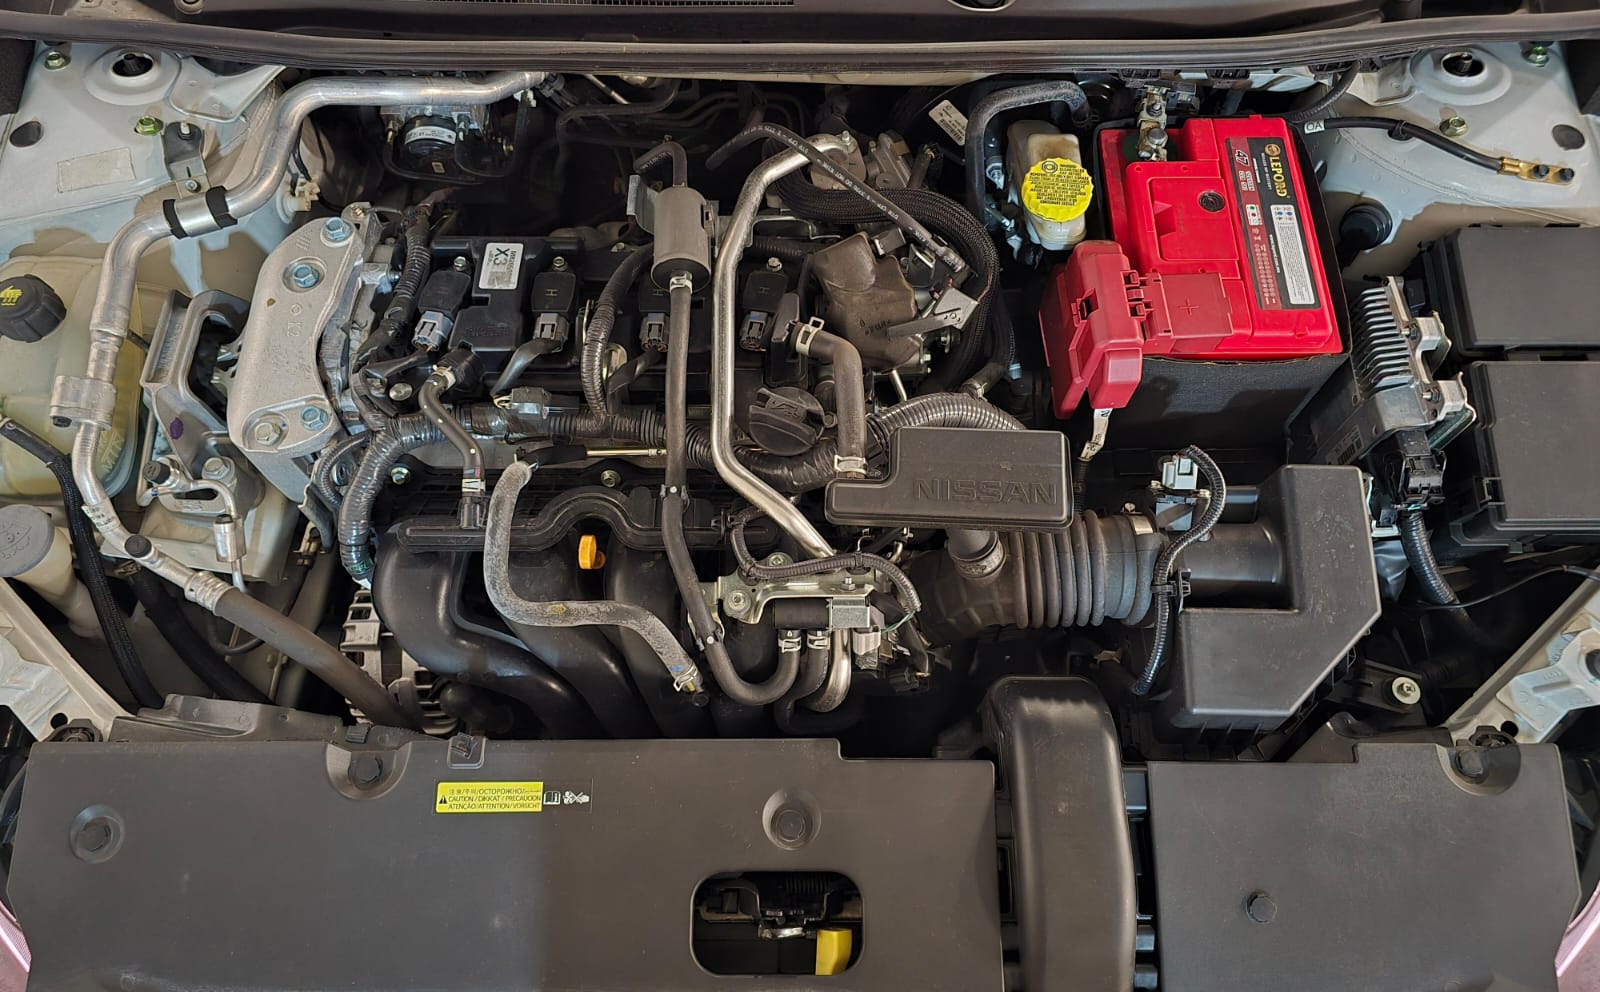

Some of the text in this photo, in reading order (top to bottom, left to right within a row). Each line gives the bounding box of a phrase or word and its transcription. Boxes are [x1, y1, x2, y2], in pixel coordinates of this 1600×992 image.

[1235, 149, 1250, 167] 47
[1269, 156, 1288, 197] LEPORD
[493, 247, 511, 266] X3
[912, 478, 1057, 505] NISSAN
